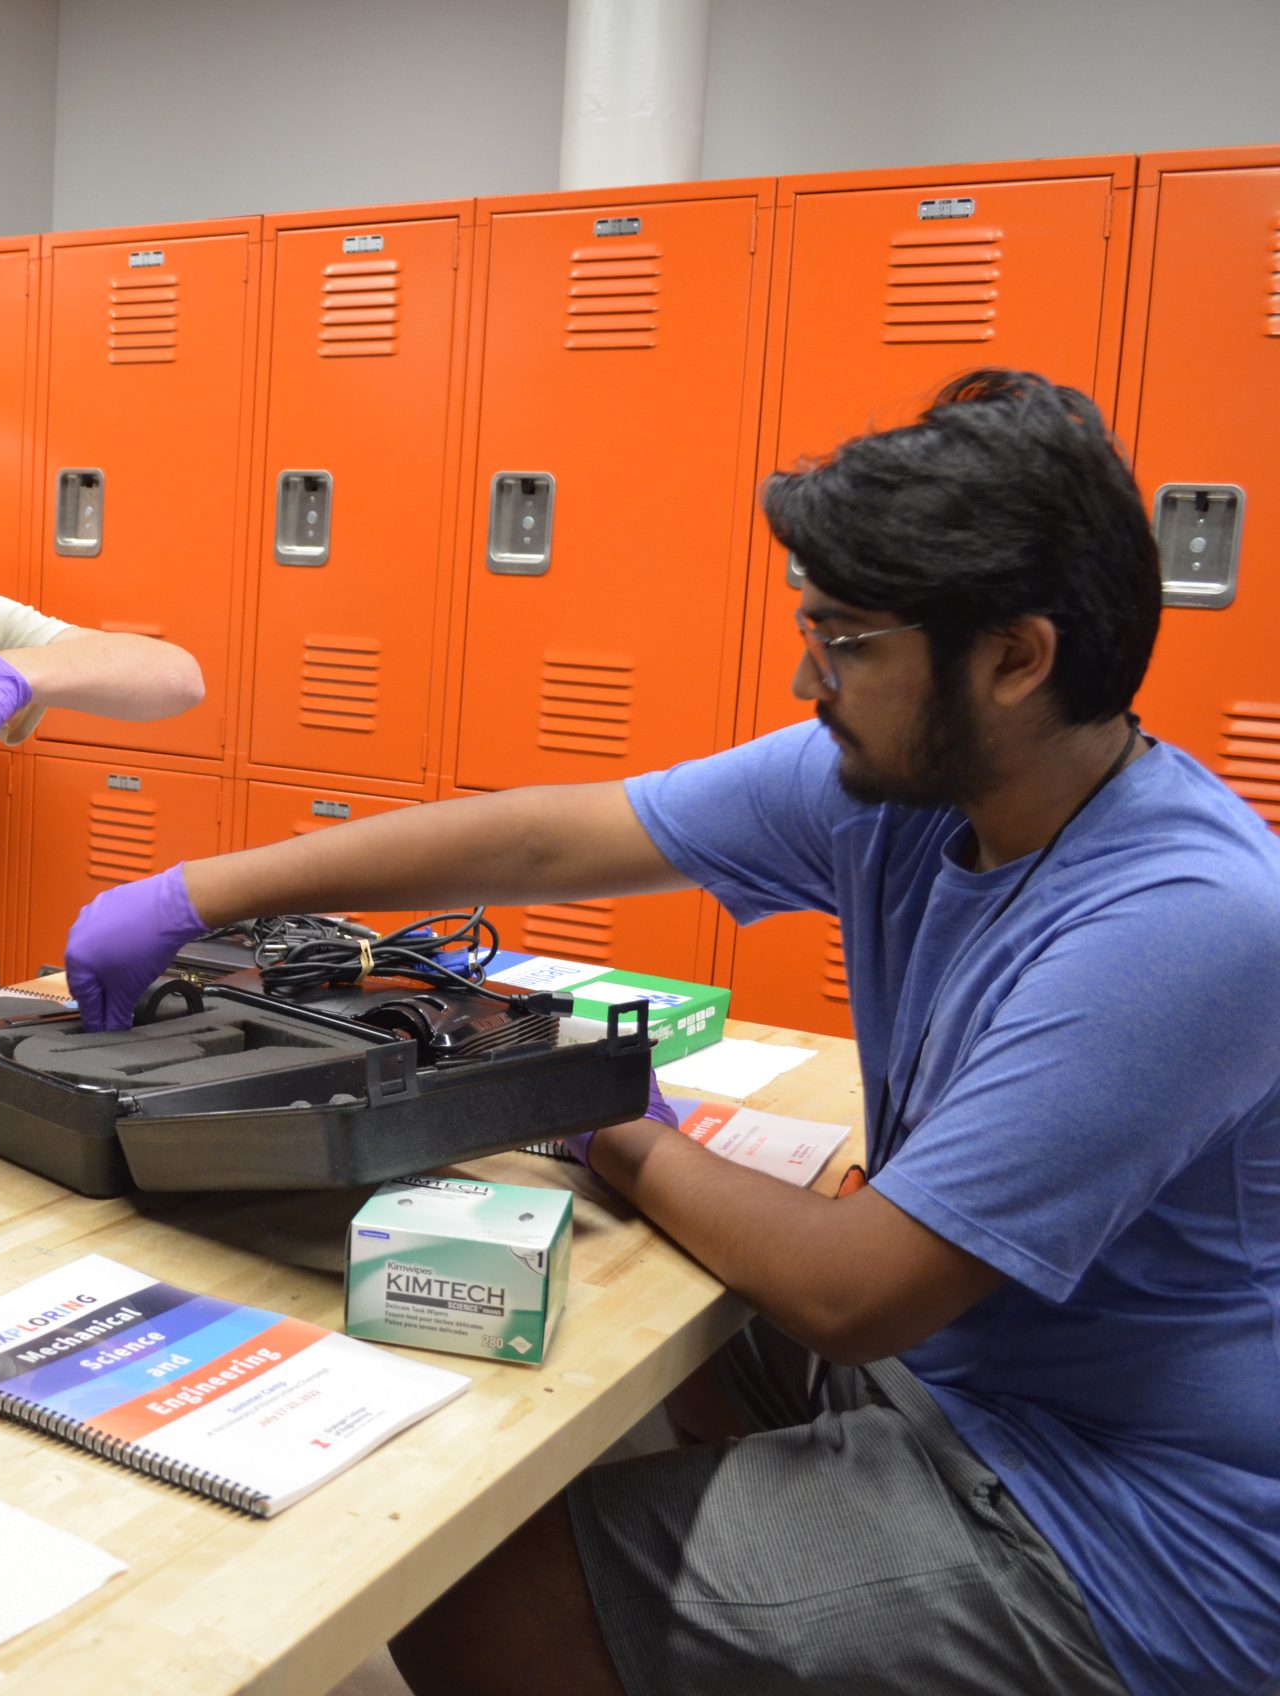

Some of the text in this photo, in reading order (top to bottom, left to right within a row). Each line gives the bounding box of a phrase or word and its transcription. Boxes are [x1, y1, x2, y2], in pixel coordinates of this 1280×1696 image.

[387, 1261, 433, 1276] Kimwipes
[386, 1272, 505, 1306] KIMTECH
[386, 1302, 410, 1311] Delicate
[426, 1309, 449, 1317] Wipers
[16, 1306, 143, 1364] Mechanical
[480, 1335, 504, 1349] 280
[79, 1330, 166, 1371] Science
[145, 1353, 192, 1378] and
[145, 1347, 283, 1415] Engineering
